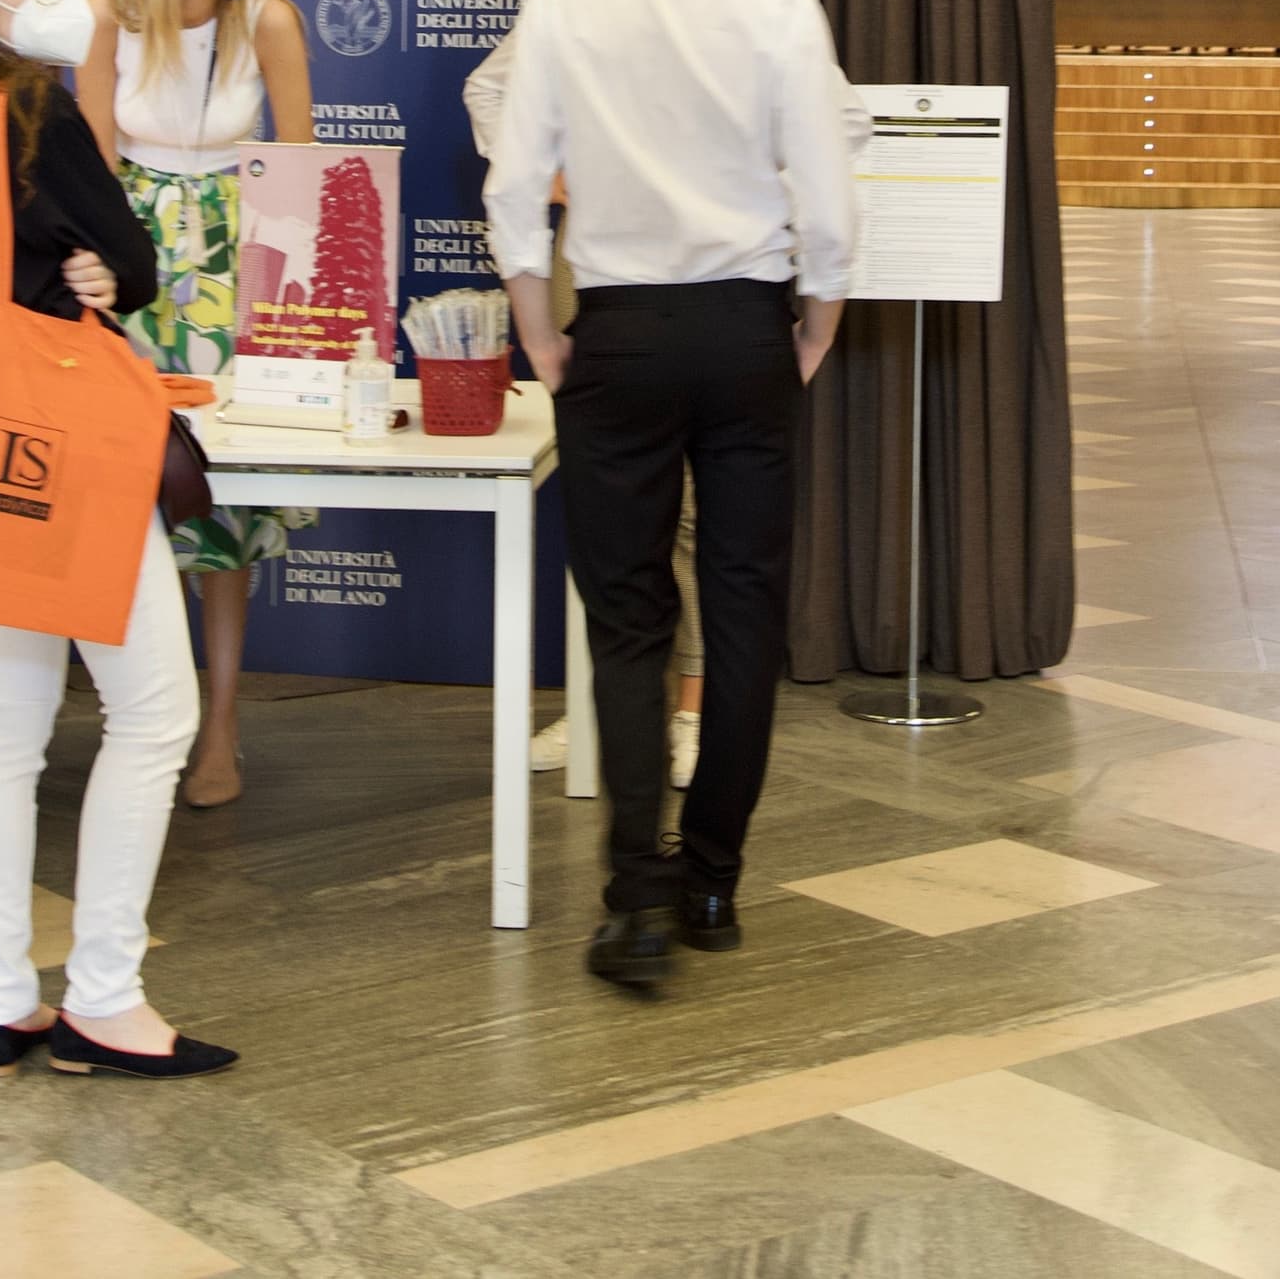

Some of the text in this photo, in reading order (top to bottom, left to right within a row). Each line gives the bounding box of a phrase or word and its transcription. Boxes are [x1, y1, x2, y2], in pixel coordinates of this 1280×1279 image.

[416, 14, 517, 29] DEGLI STU
[416, 33, 503, 48] DI MILAN
[313, 123, 406, 140] GLI STUDI
[414, 239, 471, 254] DEGLI
[414, 258, 436, 273] DI
[285, 549, 397, 568] UNIVERSITÀ
[284, 568, 403, 588] DEGLI STUDI
[284, 587, 387, 607] DI MILANO
